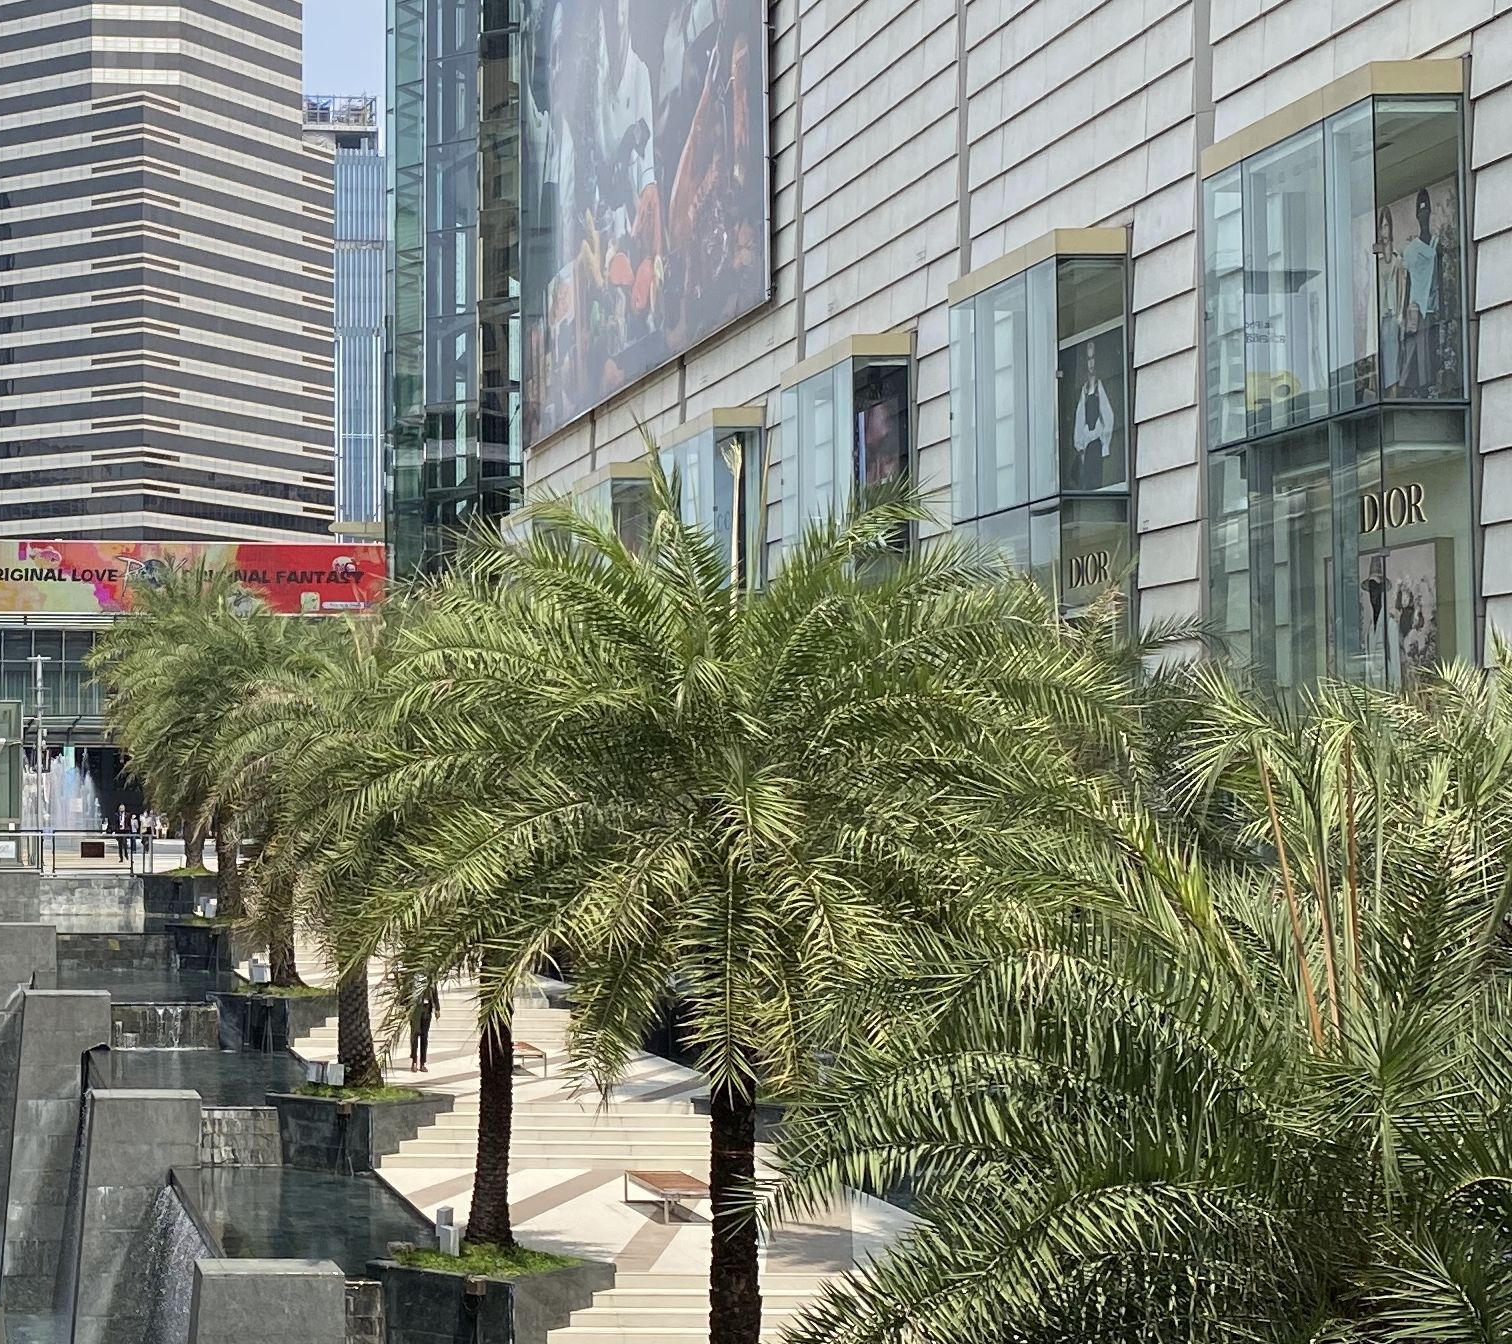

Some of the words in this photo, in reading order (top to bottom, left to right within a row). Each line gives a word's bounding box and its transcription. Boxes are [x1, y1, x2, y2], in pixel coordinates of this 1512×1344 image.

[1359, 482, 1427, 534] DIOR
[71, 568, 119, 582] LOVE
[1069, 551, 1111, 589] DIOR
